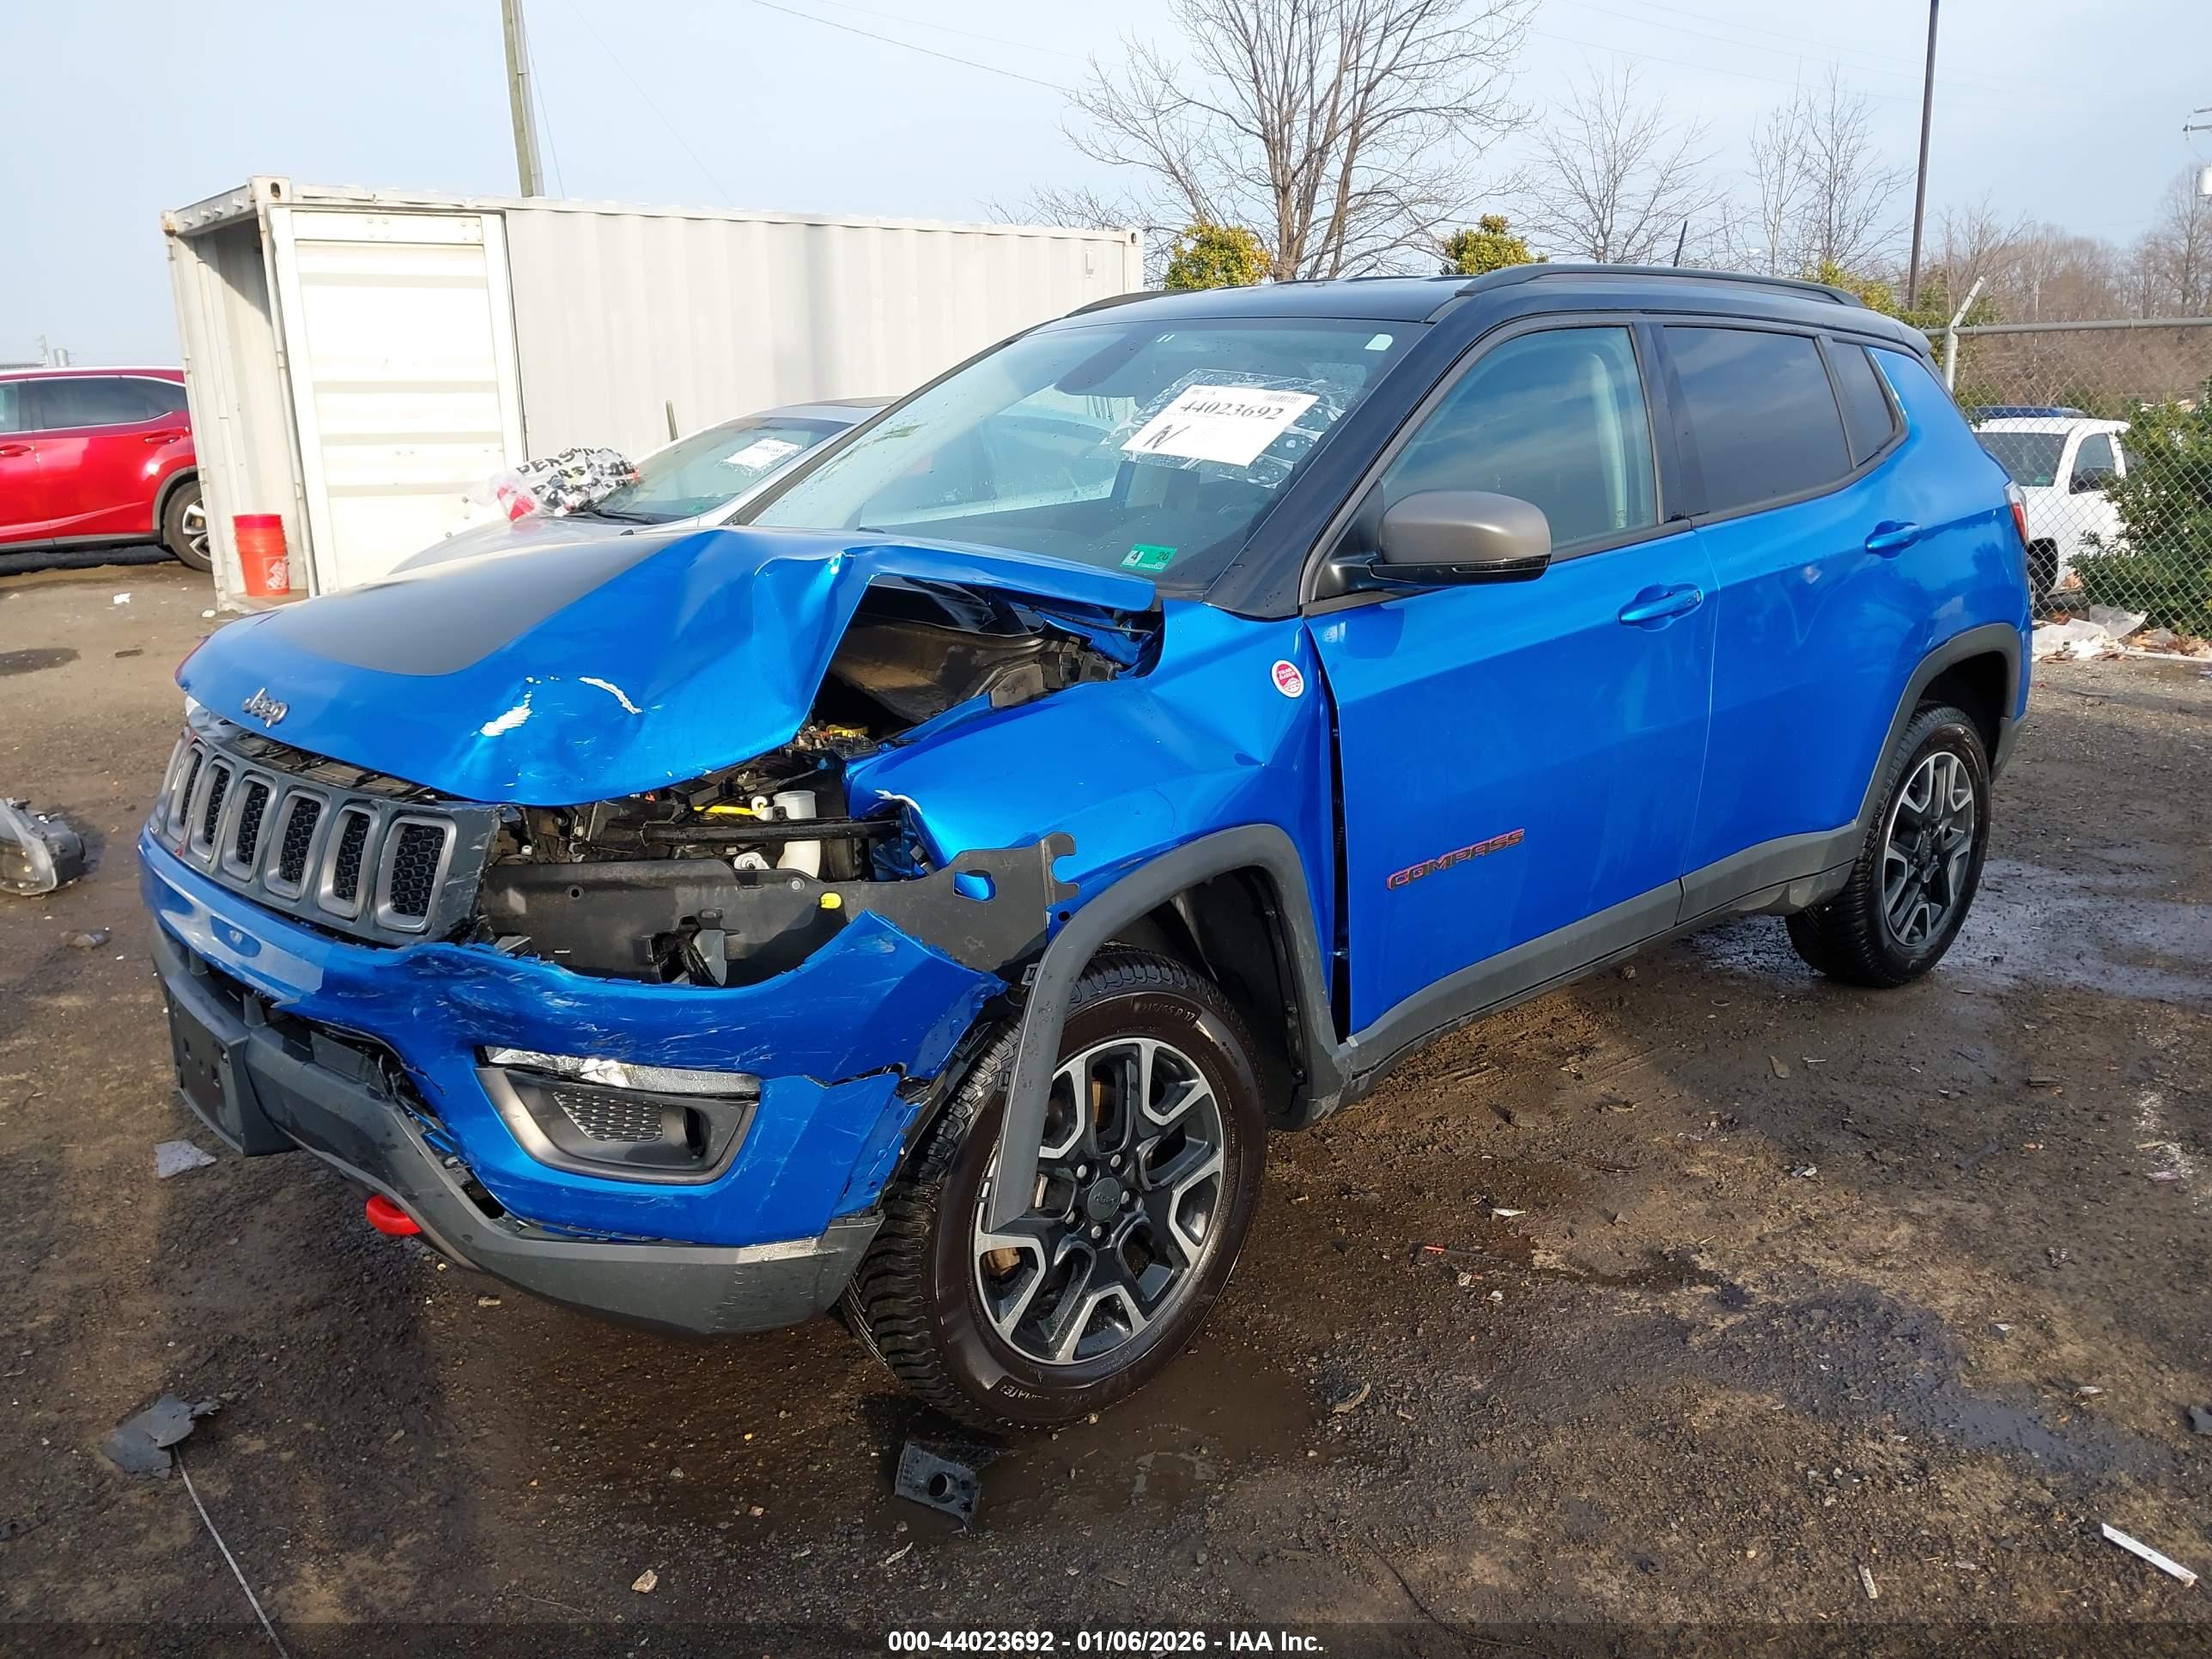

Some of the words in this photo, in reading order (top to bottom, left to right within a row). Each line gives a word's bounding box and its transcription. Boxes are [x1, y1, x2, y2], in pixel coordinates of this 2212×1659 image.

[1180, 400, 1285, 420] 44023692
[1387, 828, 1525, 890] COMPASS
[1184, 1011, 1196, 1022] 17
